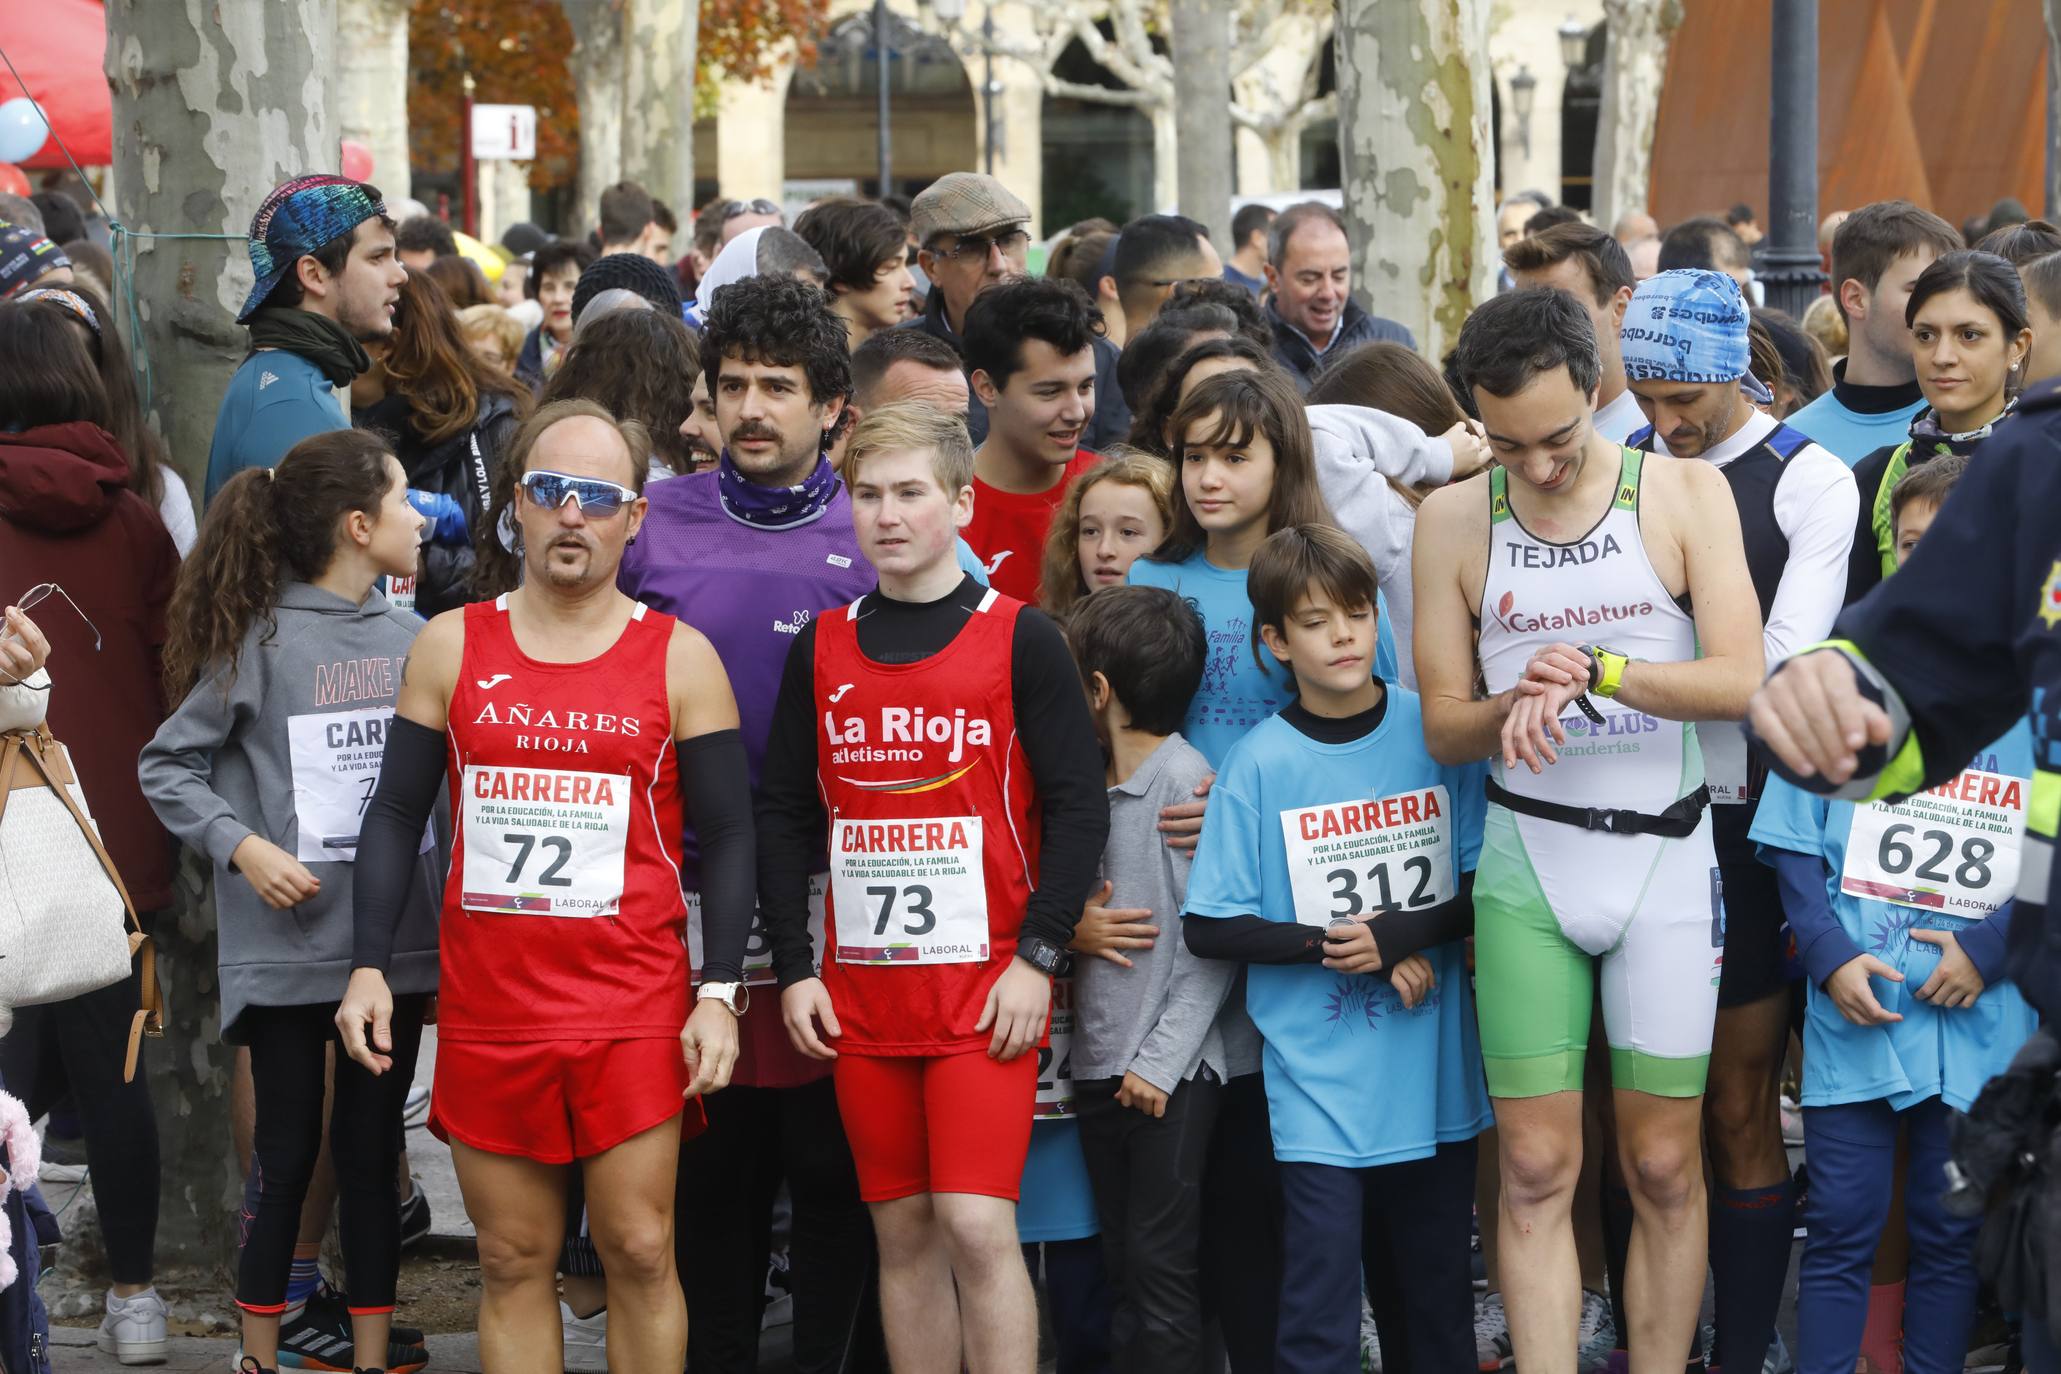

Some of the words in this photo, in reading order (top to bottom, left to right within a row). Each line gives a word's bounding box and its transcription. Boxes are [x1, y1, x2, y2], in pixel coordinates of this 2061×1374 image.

[474, 457, 488, 484] LOLA
[1494, 495, 1505, 513] IN
[1620, 487, 1635, 502] IN
[1506, 533, 1622, 569] TEJADA
[1509, 601, 1653, 633] CataNatura
[1208, 630, 1245, 644] Familia
[315, 657, 394, 706] MAKE
[473, 702, 640, 737] AÑARES
[516, 735, 589, 754] RIOJA
[825, 711, 866, 745] La
[881, 707, 992, 763] Rioja
[331, 765, 336, 773] Y
[338, 764, 348, 772] LA
[350, 762, 367, 771] VIDA
[337, 753, 352, 762] POR
[354, 752, 363, 761] LA
[832, 746, 923, 764] atletismo
[474, 771, 614, 806] CARRERA
[475, 816, 480, 824] Y
[481, 816, 491, 824] LA
[492, 817, 509, 826] VIDA
[511, 818, 557, 828] SALUDABLE
[560, 820, 569, 829] DE
[572, 821, 582, 830] LA
[584, 822, 609, 831] RIOJA
[481, 805, 495, 814] POR
[497, 806, 506, 814] LA
[508, 806, 556, 818] EDUCACIÓN,
[557, 810, 567, 819] LA
[570, 811, 603, 820] FAMILIA
[1299, 791, 1441, 841] CARRERA
[1872, 803, 1878, 811] Y
[1879, 804, 1890, 813] LA
[1891, 806, 1910, 816] VIDA
[1913, 808, 1961, 826] SALUDABLE
[1962, 818, 1973, 828] DE
[1975, 821, 1986, 830] LA
[1987, 823, 2013, 835] RIOJA
[1911, 798, 1960, 815] EDUCACIÓN,
[1962, 808, 1973, 817] LA
[1974, 809, 2008, 823] FAMILIA
[841, 822, 969, 853] CARRERA
[1308, 858, 1313, 866] Y
[1315, 855, 1326, 865] LA
[1327, 853, 1348, 863] VIDA
[1350, 844, 1395, 860] SALUDABLE
[1397, 842, 1408, 851] DE
[1409, 840, 1420, 850] LA
[1421, 836, 1441, 848] RIOJA
[1313, 845, 1329, 854] POR
[1331, 843, 1342, 852] LA
[1343, 834, 1391, 850] EDUCACIÓN,
[1393, 832, 1403, 841] LA
[1405, 825, 1435, 839] FAMILIA
[504, 833, 572, 887] 72
[845, 859, 857, 867] POR
[858, 859, 866, 867] LA
[868, 857, 911, 868] EDUCACIÓN,
[914, 857, 924, 866] LA
[926, 856, 960, 866] FAMILIA
[1878, 823, 1995, 889] 628
[841, 870, 846, 878] Y
[854, 870, 870, 878] VIDA
[871, 868, 916, 878] SALUDABLE
[918, 869, 927, 877] DE
[930, 868, 940, 876] LA
[942, 867, 967, 876] RIOJA
[1326, 855, 1435, 918] 312
[556, 898, 604, 909] LABORAL
[866, 884, 936, 936] 73
[1949, 896, 2000, 911] LABORAL
[923, 944, 972, 955] LABORAL
